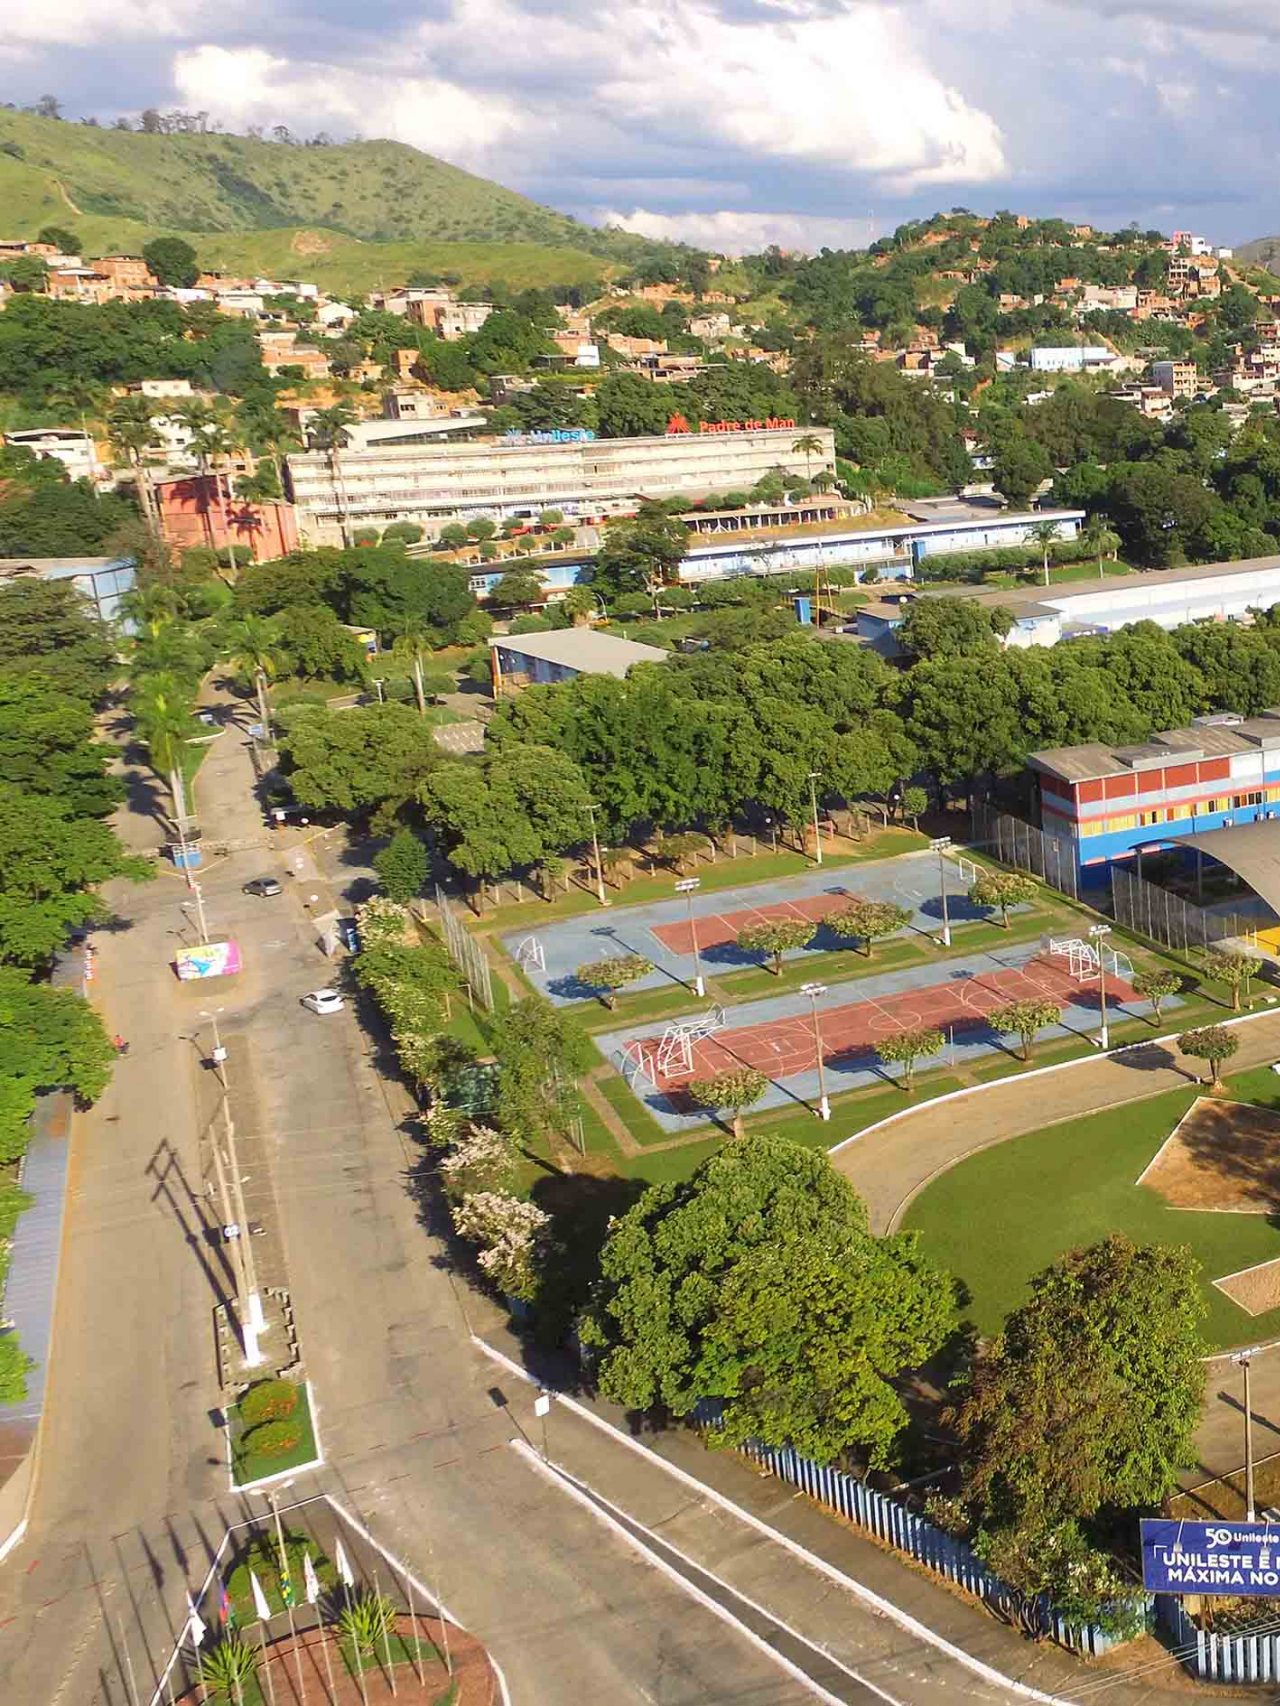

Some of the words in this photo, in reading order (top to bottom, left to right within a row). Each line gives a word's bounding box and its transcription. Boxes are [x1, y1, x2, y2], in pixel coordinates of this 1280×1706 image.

[699, 419, 741, 432] Padre
[745, 418, 761, 430] de
[765, 417, 795, 429] Man
[1205, 1528, 1232, 1549] 50
[1233, 1532, 1280, 1544] Unileste
[1163, 1552, 1253, 1569] UNILESTE
[1168, 1565, 1245, 1585] MÁXIMA
[1250, 1570, 1279, 1586] NO
